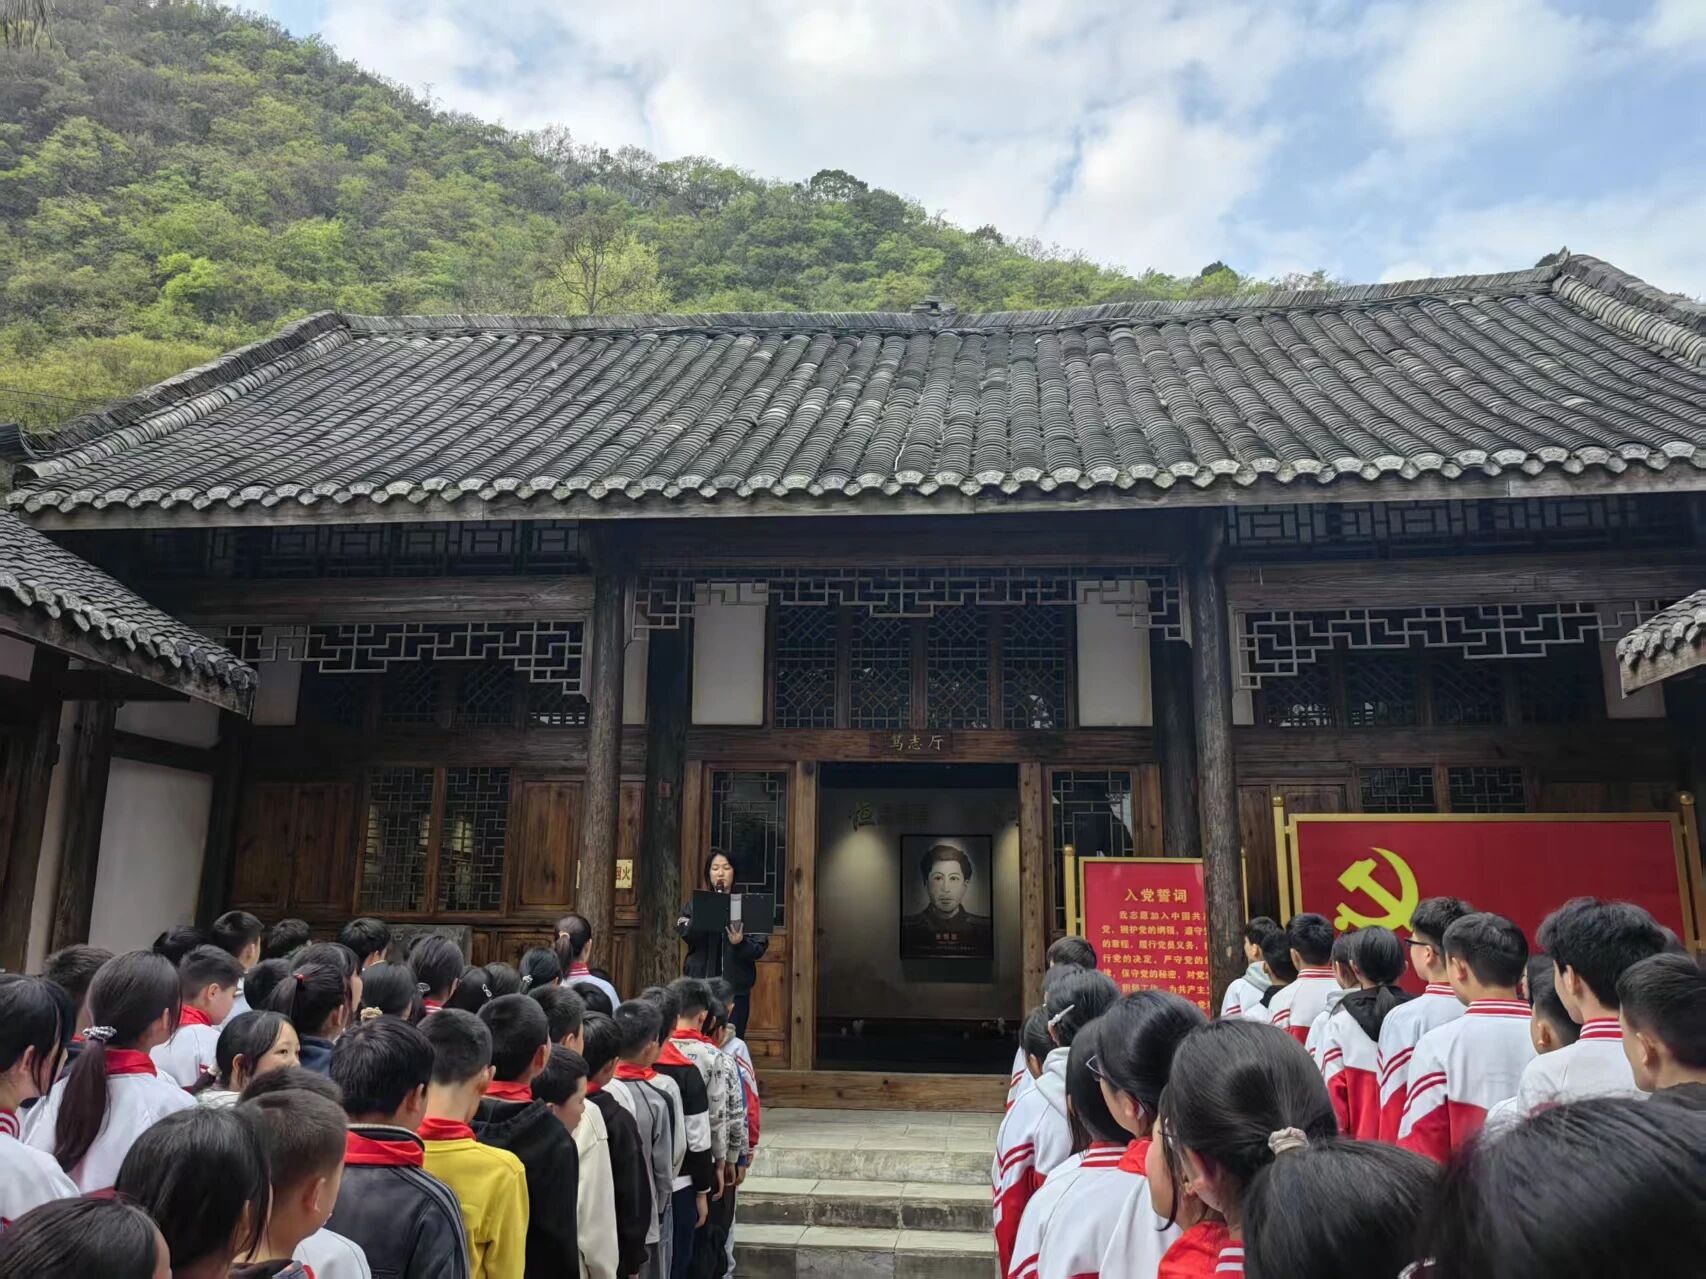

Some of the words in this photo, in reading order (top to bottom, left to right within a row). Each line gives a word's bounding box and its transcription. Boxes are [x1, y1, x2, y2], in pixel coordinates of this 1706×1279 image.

[1124, 888, 1187, 903] 入党誓词
[1119, 911, 1206, 921] 我志愿加入中国共
